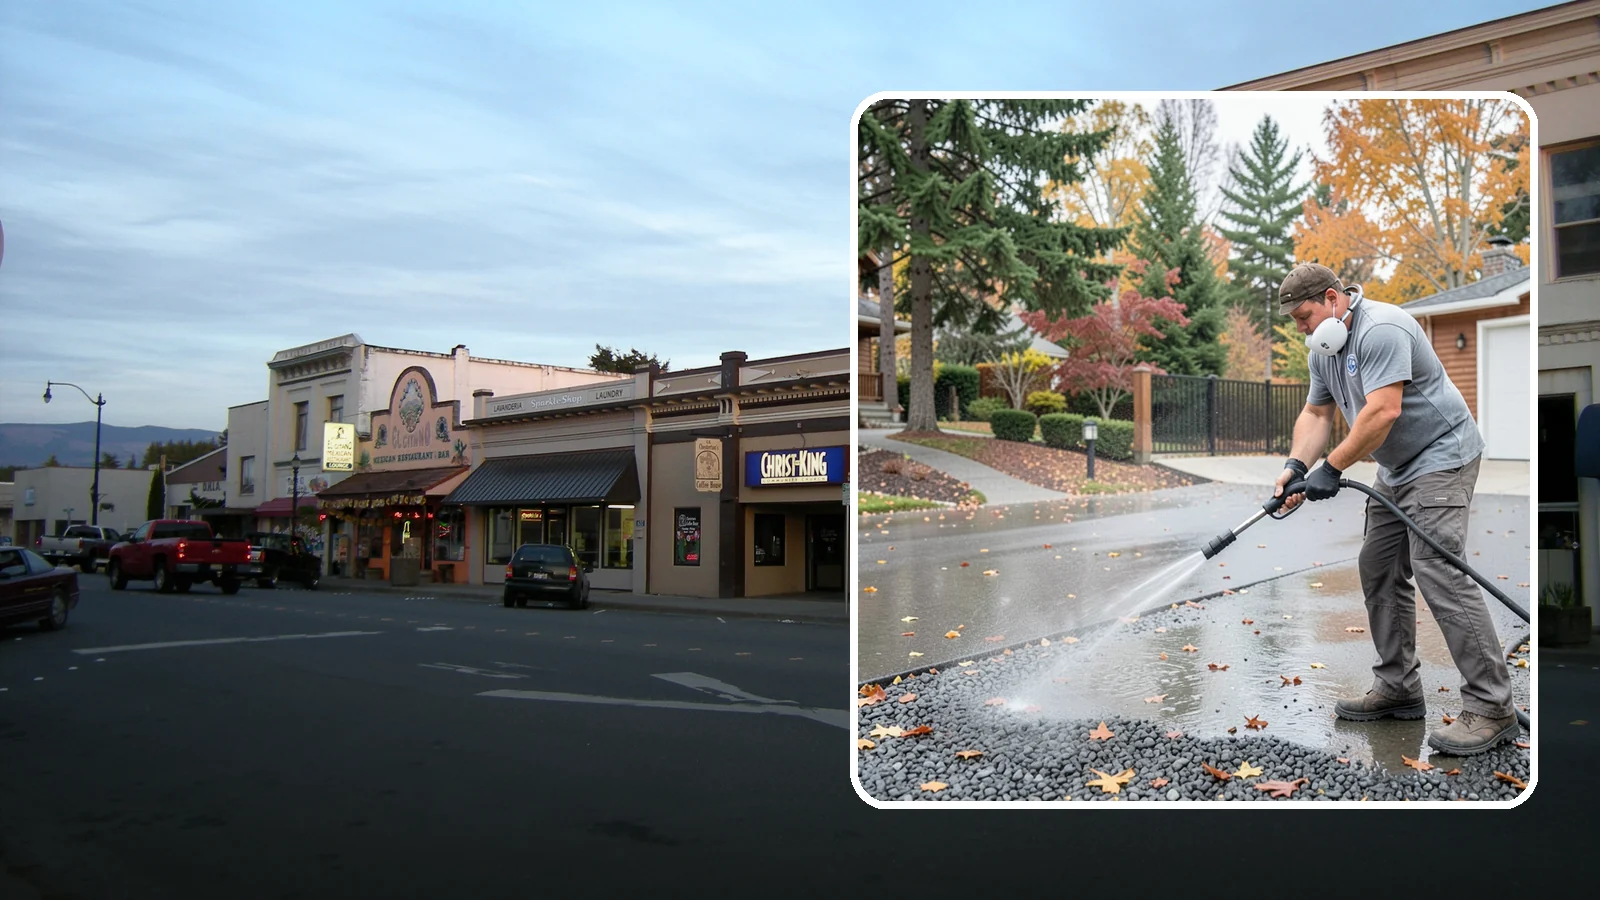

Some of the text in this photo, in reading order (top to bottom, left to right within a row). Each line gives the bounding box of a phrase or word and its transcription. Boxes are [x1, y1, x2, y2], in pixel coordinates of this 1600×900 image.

[493, 402, 523, 412] LAVANDERIA
[561, 394, 582, 406] Shop
[595, 389, 623, 400] LAUNDRY
[373, 454, 396, 464] MEXICAN
[397, 451, 434, 462] RESTAURANT
[437, 450, 450, 459] BAR
[761, 450, 827, 478] CHRIST KING
[696, 480, 709, 489] Coffee
